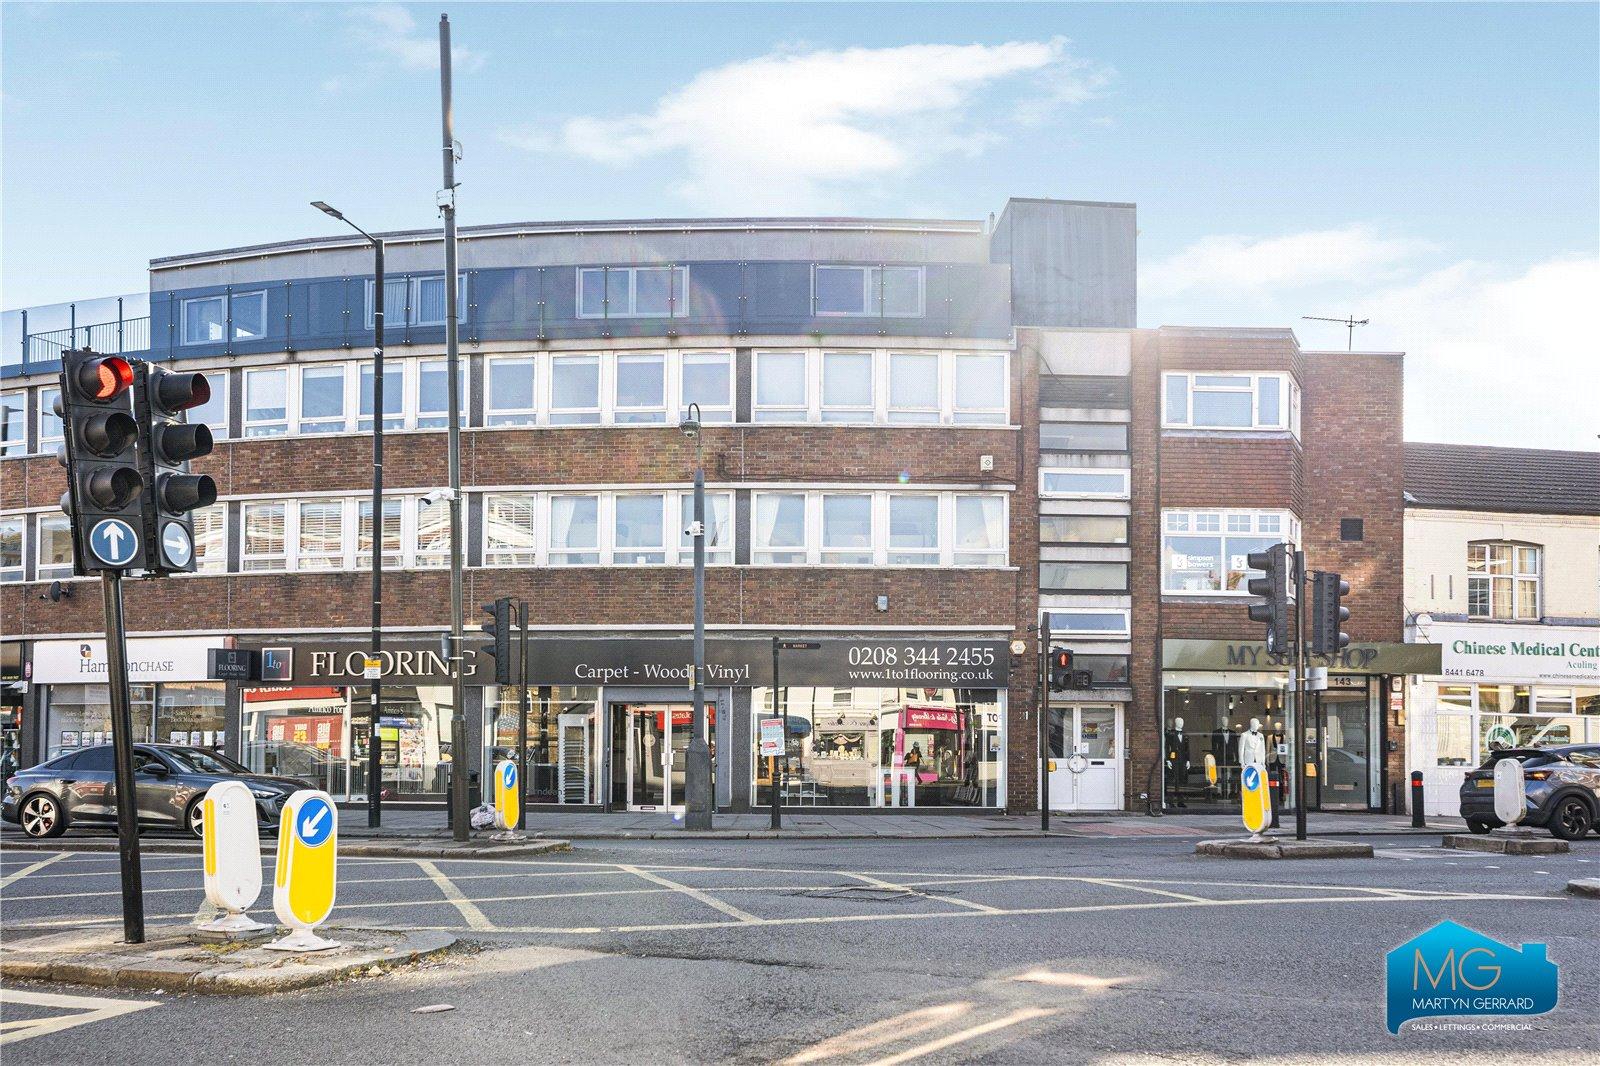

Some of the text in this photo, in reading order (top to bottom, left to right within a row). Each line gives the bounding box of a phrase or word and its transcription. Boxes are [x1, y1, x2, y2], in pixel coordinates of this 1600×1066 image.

[1187, 554, 1214, 562] simpson
[1227, 645, 1263, 666] MY
[1452, 640, 1506, 656] Chinese
[1511, 641, 1565, 657] Medical
[848, 646, 995, 666] 0208 344 2455
[79, 659, 174, 673] HamonCHASE
[1445, 668, 1485, 677] 8441 6478
[1566, 661, 1598, 671] Aculing
[575, 664, 628, 683] Carpet
[644, 664, 691, 679] Wood
[706, 664, 750, 683] Vinyl
[849, 668, 994, 683] www.1to1flooring.co.uk
[1334, 678, 1351, 686] 143
